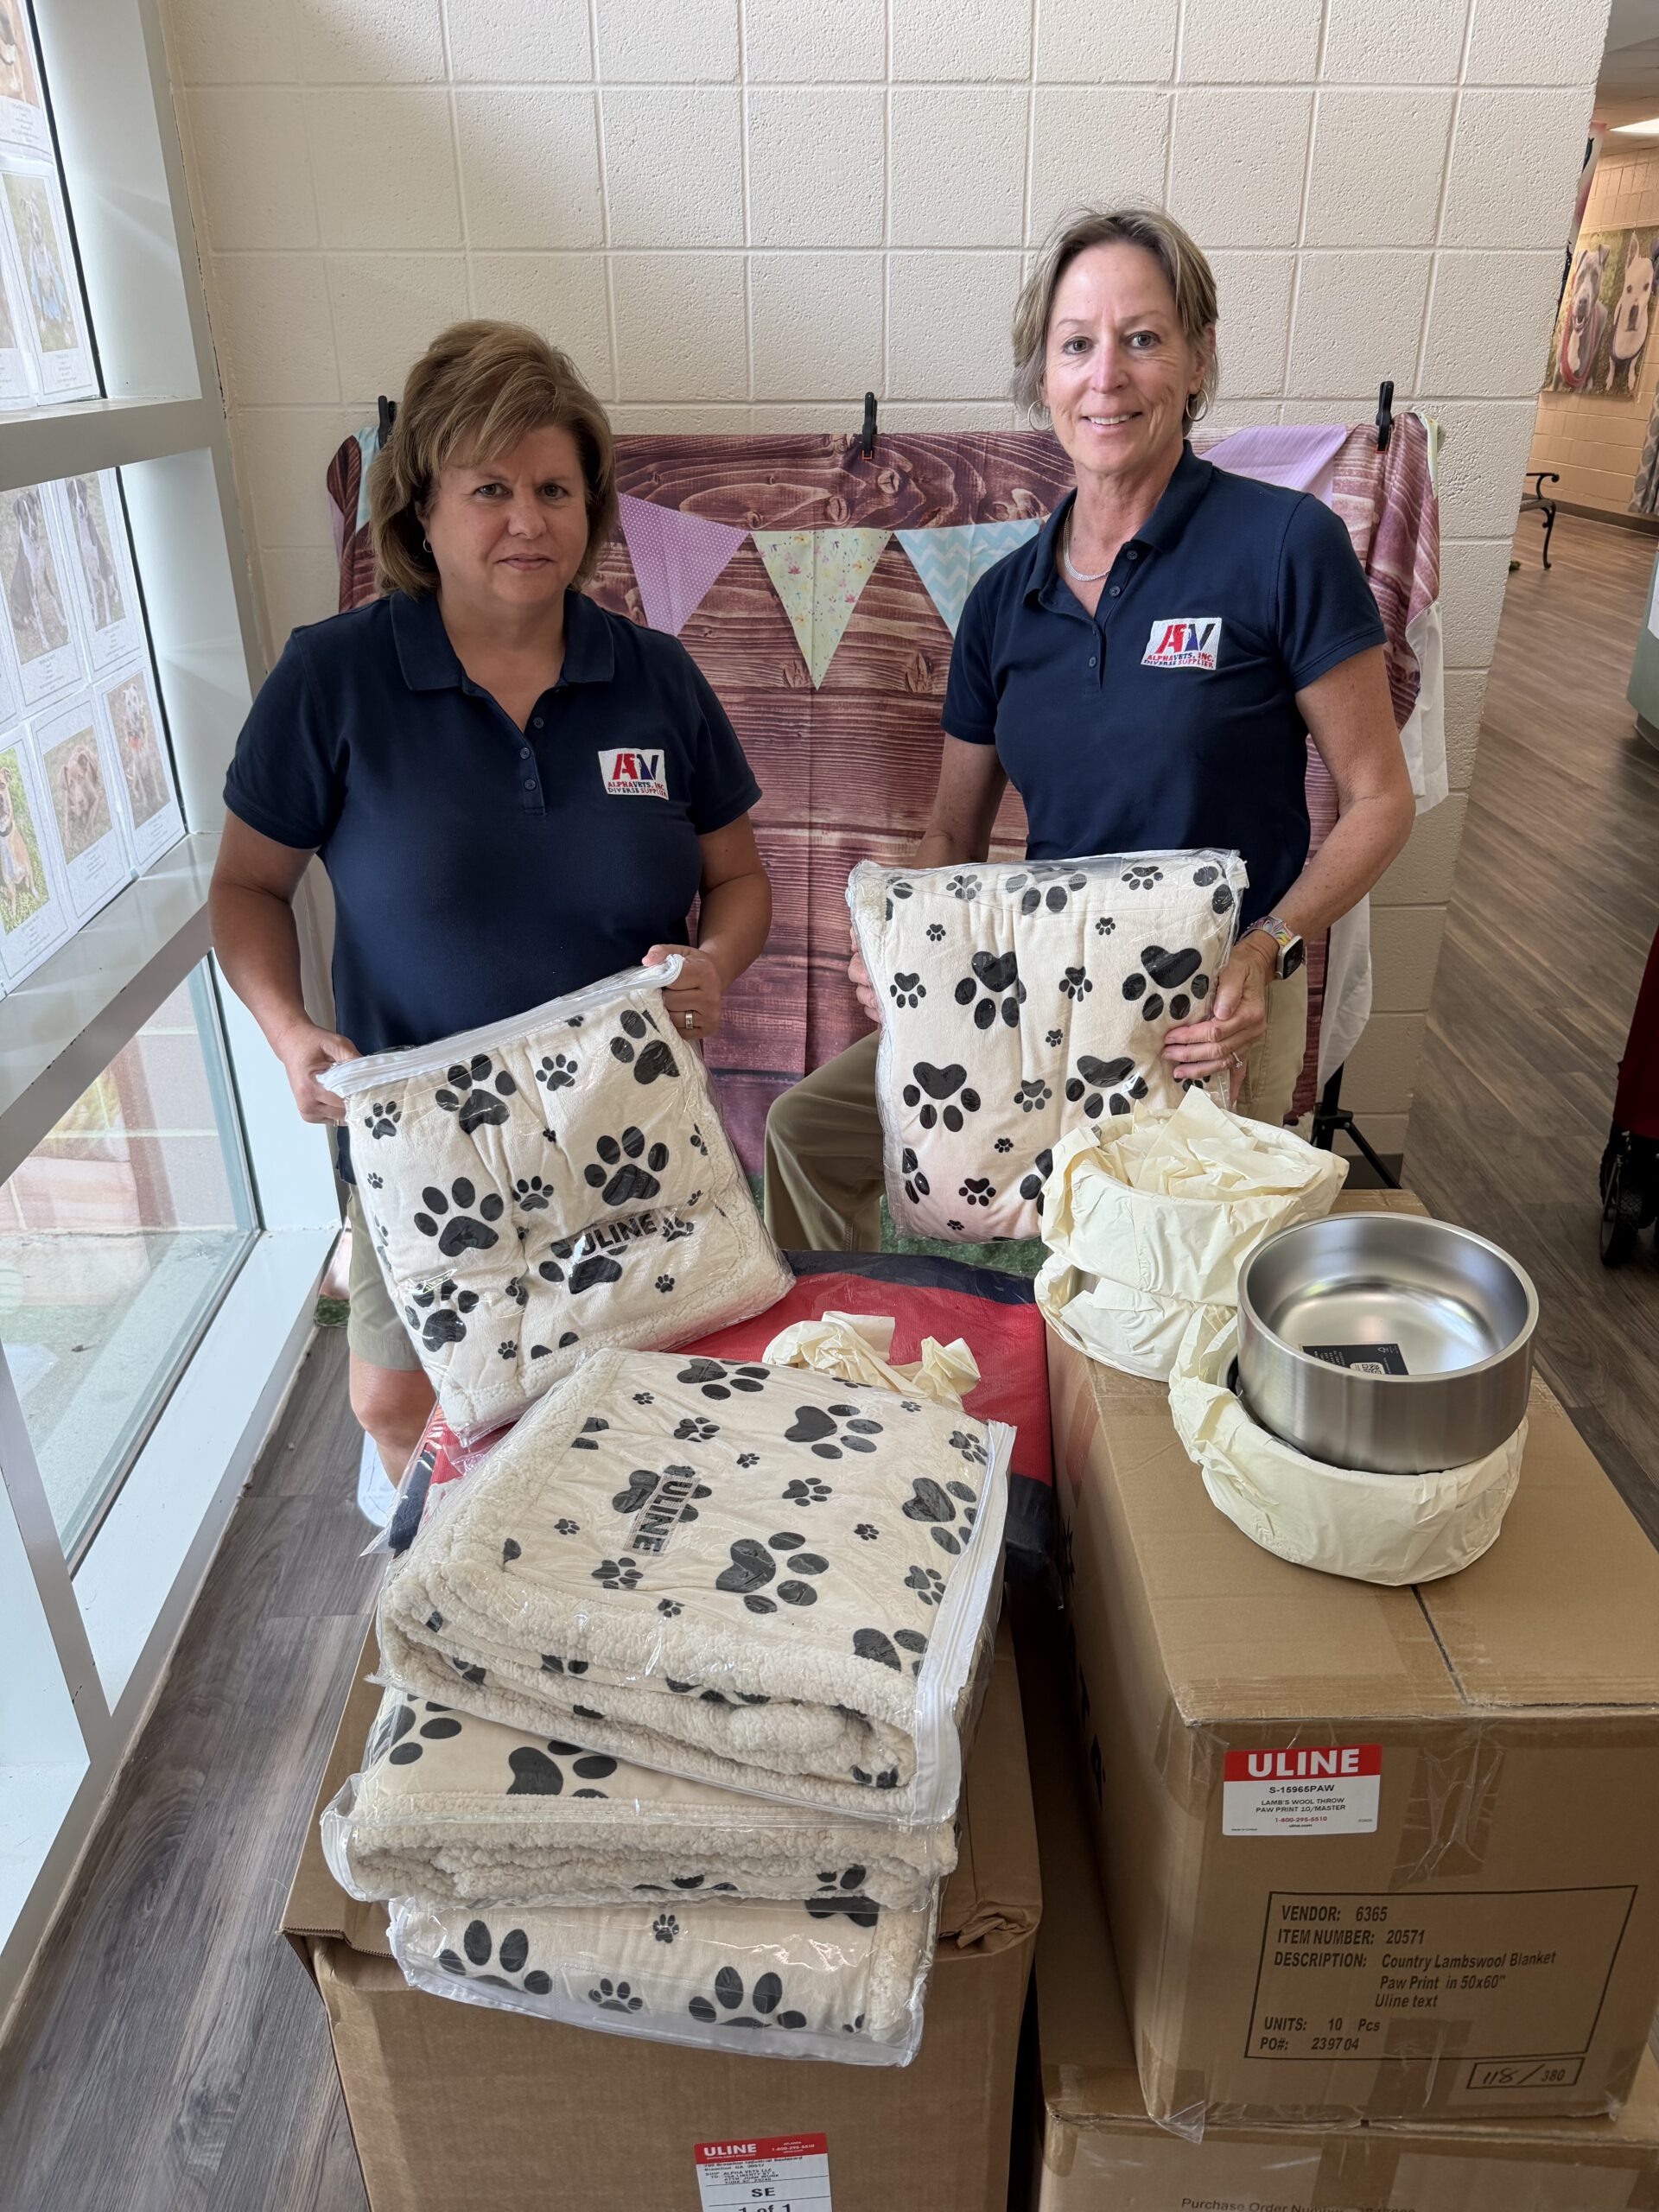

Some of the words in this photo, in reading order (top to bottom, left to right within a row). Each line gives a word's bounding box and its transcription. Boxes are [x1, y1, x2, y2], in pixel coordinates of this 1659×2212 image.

[1178, 658, 1214, 669] SUPPLIER
[575, 1213, 658, 1255] ULINE
[632, 1481, 692, 1552] ULINE
[1248, 1749, 1360, 1777] ULINE
[1268, 1784, 1335, 1794] S-15965PAW
[1281, 1905, 1340, 1922] VENDOR:
[1356, 1906, 1388, 1922] 6365
[1278, 1929, 1311, 1944] ITEM
[1313, 1929, 1375, 1945] NUMBER:
[1386, 1929, 1425, 1944] 20571
[1274, 1951, 1367, 1967] DESCRIPTION:
[1382, 1953, 1432, 1972] Country
[1434, 1953, 1506, 1968] Lambswool
[1510, 1950, 1557, 1967] Blanket
[1380, 1975, 1408, 1989] Paw
[1409, 1975, 1440, 1989] Print
[1446, 1975, 1457, 1989] in
[1375, 1993, 1409, 2007] Uline
[1412, 1994, 1439, 2007] text
[1264, 2016, 1306, 2031] UNITS:
[1328, 2018, 1343, 2031] 10
[1357, 2018, 1381, 2031] Pcs
[1260, 2037, 1289, 2050] PO#:
[703, 2143, 757, 2157] ULINE
[752, 2187, 775, 2197] SE
[1181, 2197, 1245, 2212] Purchase
